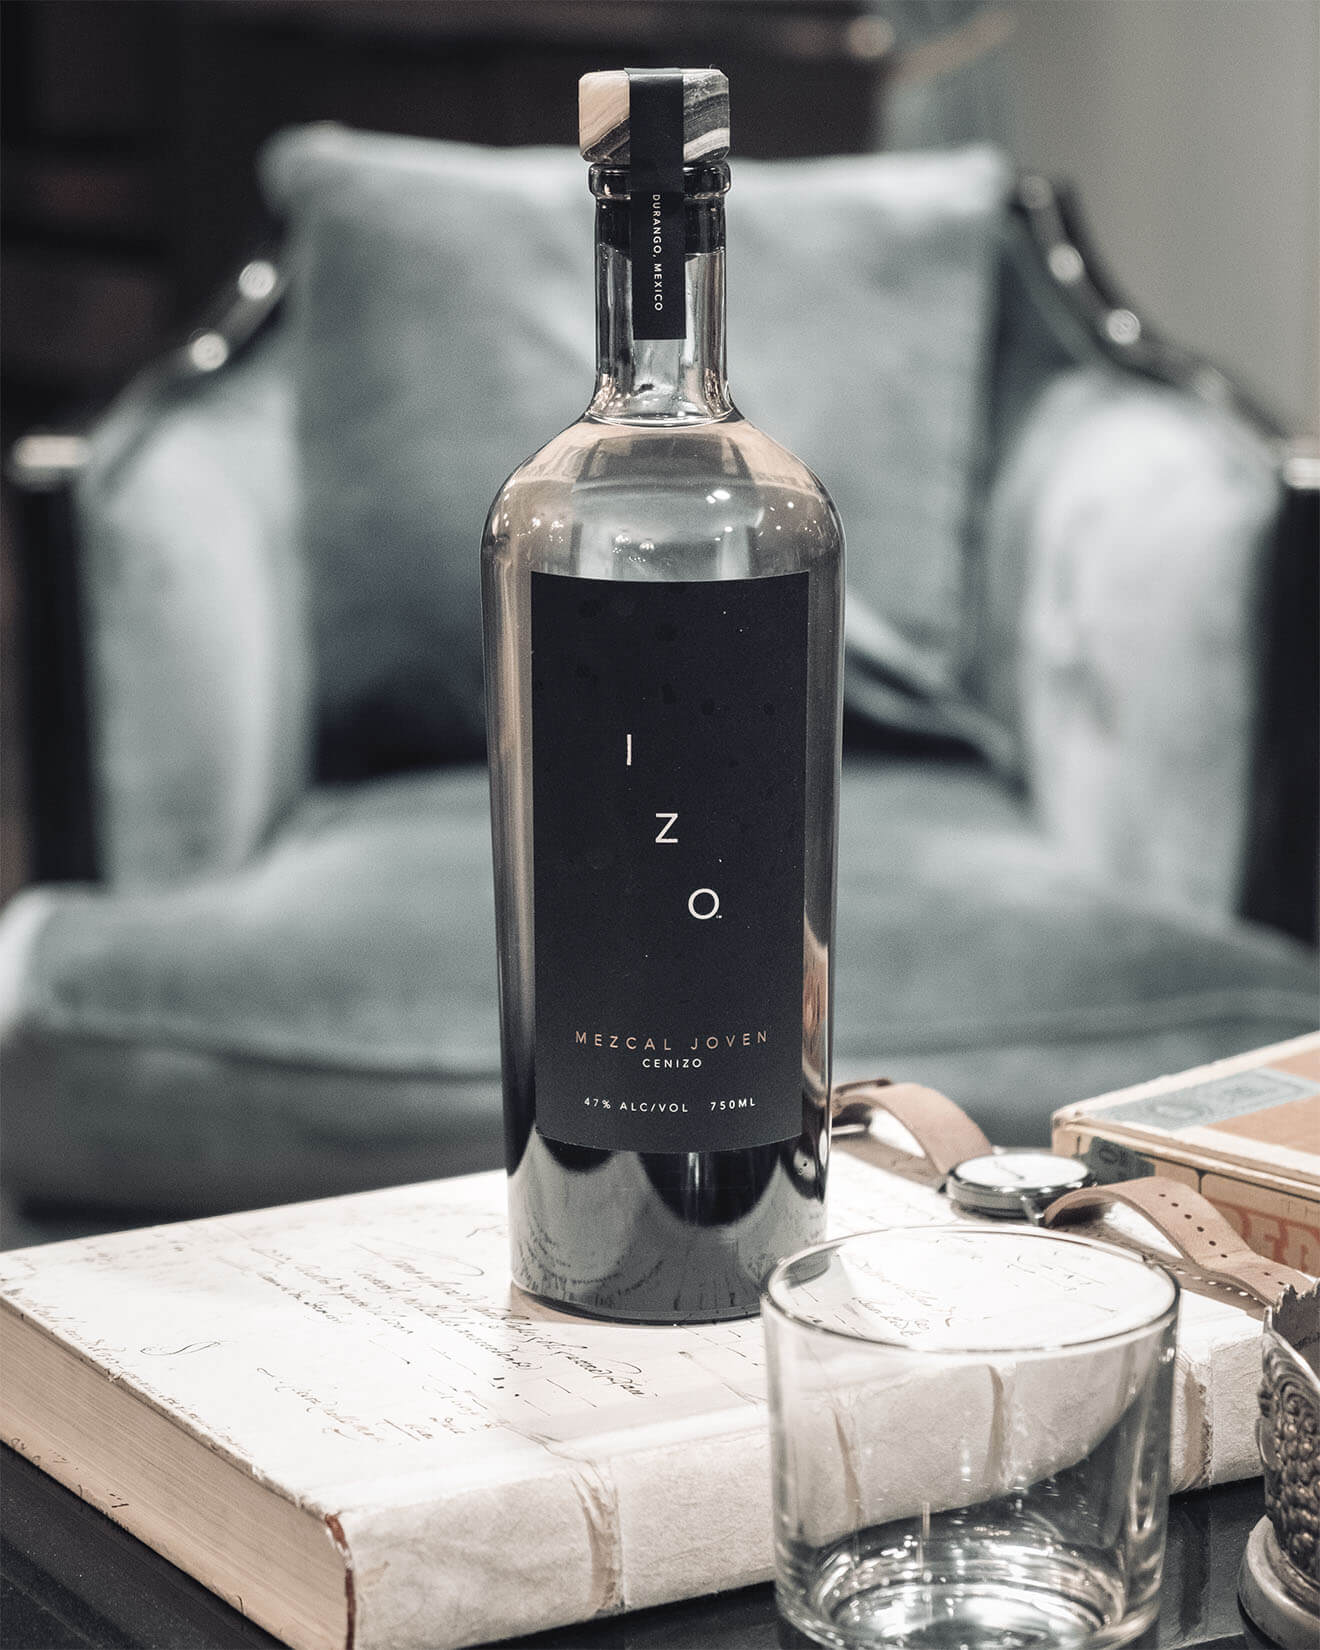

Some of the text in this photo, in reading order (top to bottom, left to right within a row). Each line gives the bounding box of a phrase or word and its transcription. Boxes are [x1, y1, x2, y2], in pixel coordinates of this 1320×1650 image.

[652, 194, 664, 312] DURANGO, MEXICO
[575, 1031, 768, 1051] MEZCAL JOVEN
[642, 1058, 702, 1069] CENIZO
[584, 1097, 756, 1113] 47% ALC/VOL 750ML
